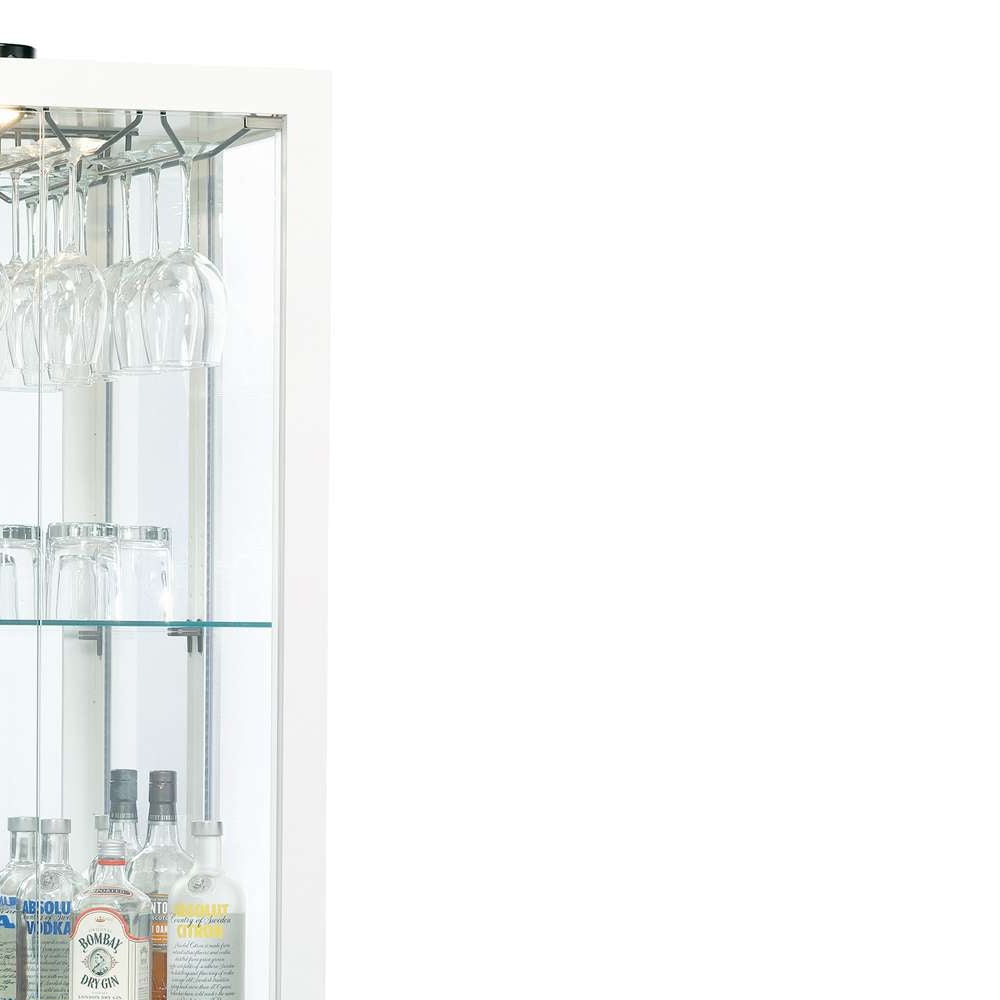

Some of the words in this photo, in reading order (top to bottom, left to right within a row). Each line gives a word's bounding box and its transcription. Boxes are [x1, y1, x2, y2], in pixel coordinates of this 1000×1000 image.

[78, 932, 123, 954] BOMBAY
[80, 974, 100, 990] DRY
[101, 975, 120, 990] GIN
